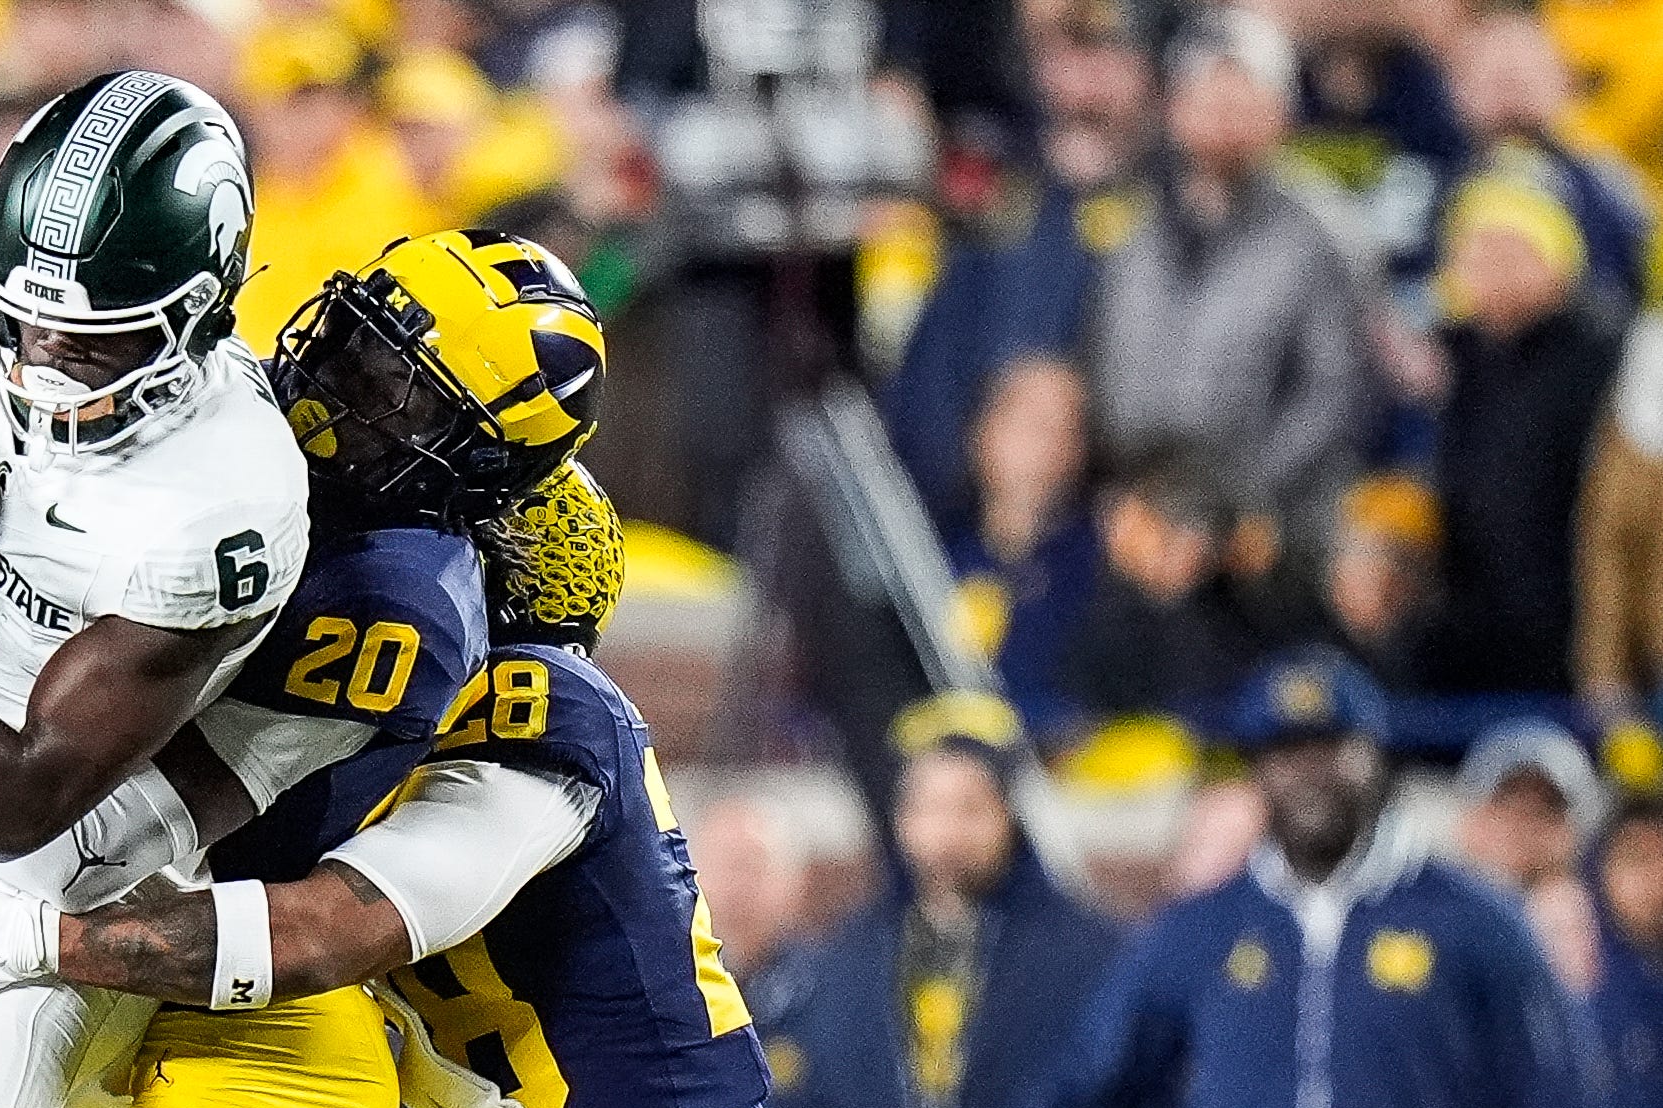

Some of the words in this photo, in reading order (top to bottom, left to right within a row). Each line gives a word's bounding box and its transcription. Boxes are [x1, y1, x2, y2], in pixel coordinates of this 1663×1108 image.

[24, 279, 66, 304] STATE
[215, 529, 269, 612] 6
[284, 616, 421, 712] 20
[434, 660, 549, 752] 28
[230, 978, 255, 1004] M
